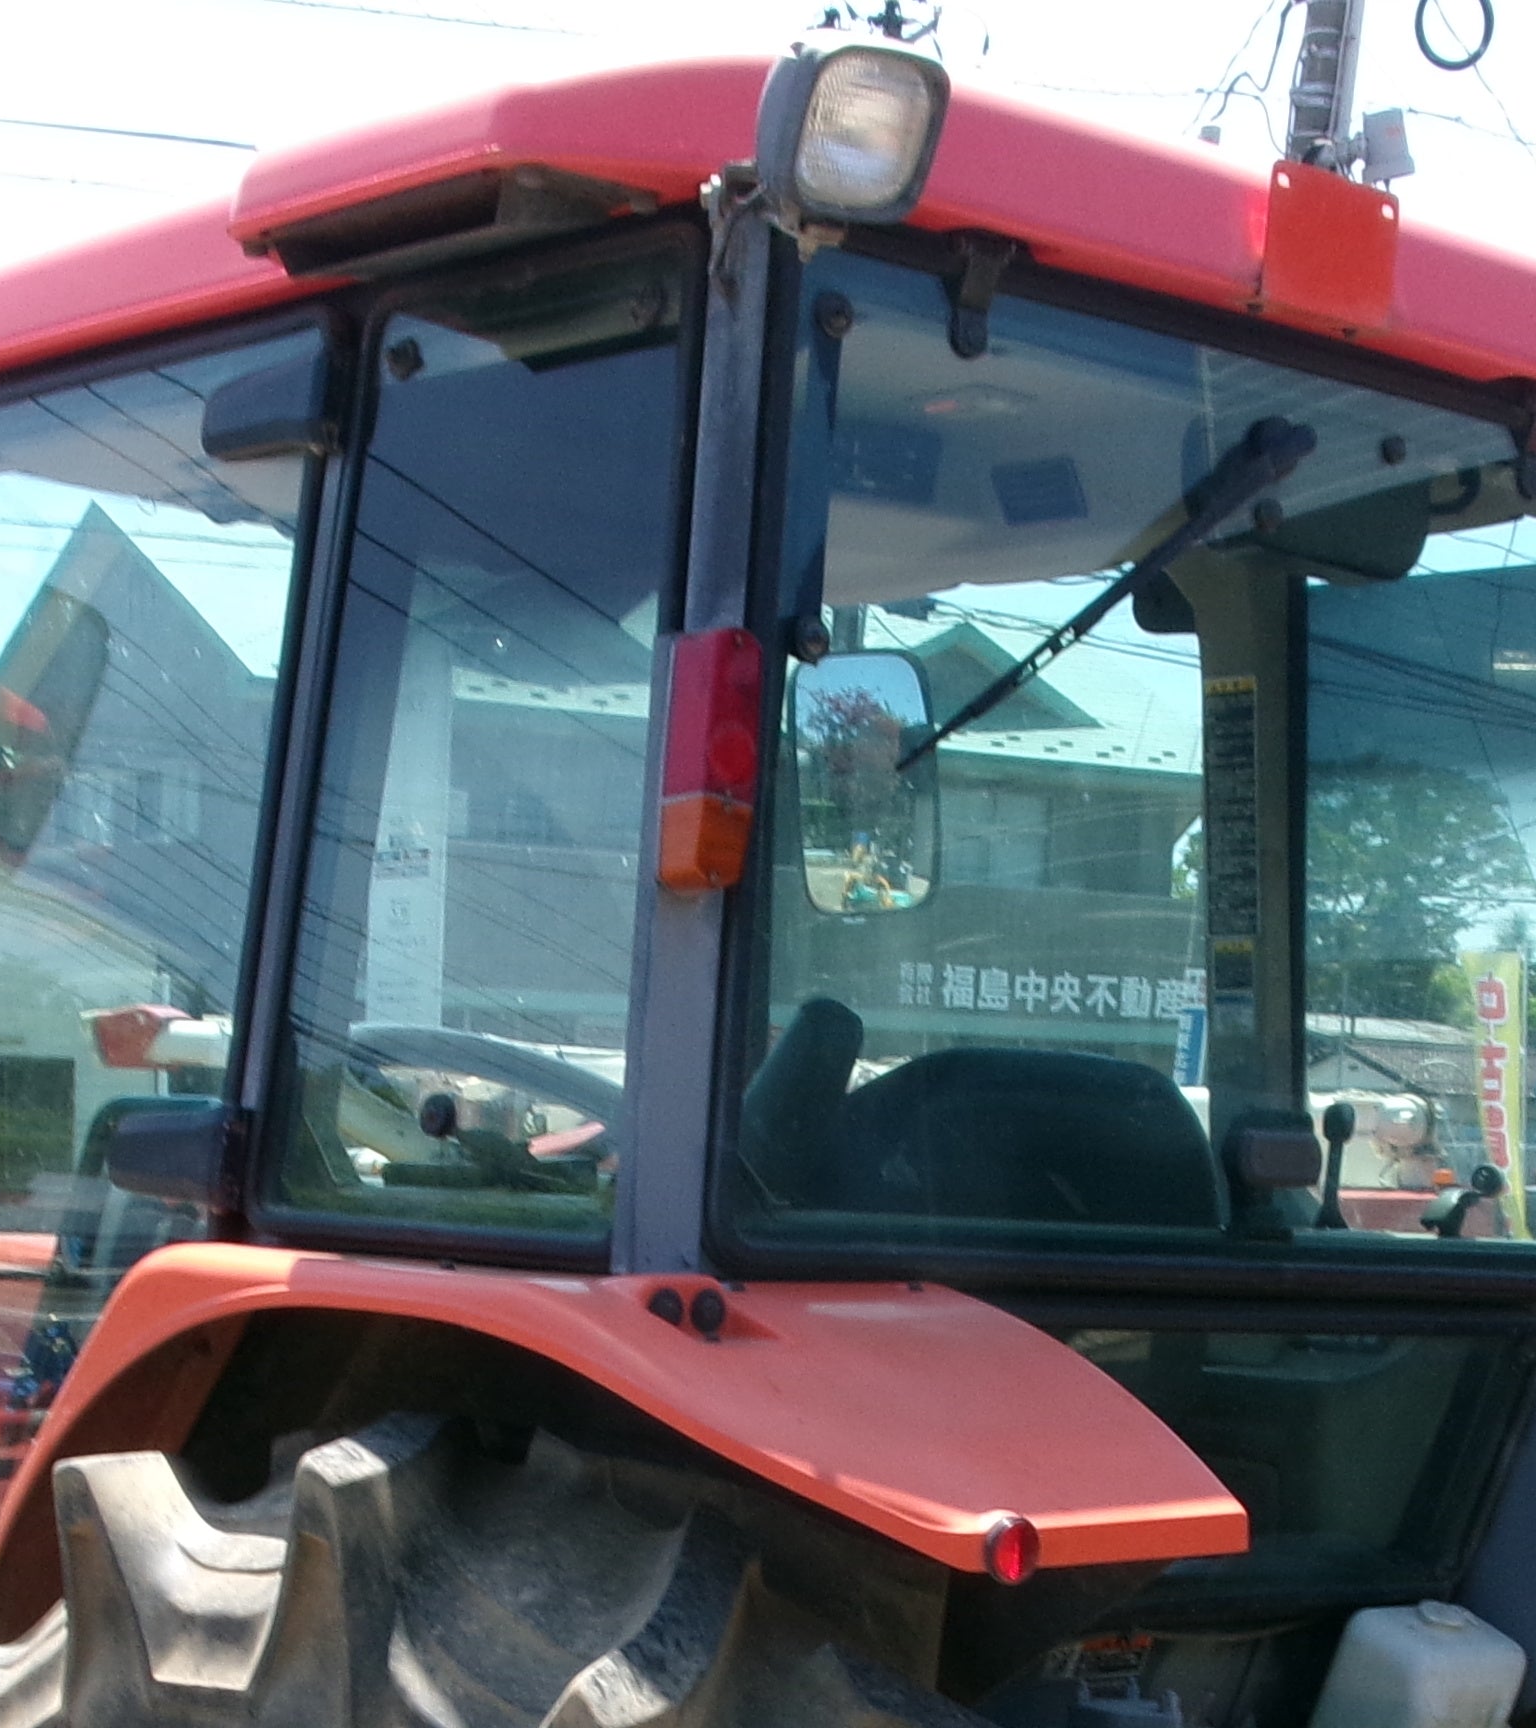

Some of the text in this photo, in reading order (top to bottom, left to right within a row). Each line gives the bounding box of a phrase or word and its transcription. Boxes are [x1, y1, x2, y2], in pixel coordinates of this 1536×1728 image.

[942, 963, 1190, 1020] 福島中央不動産
